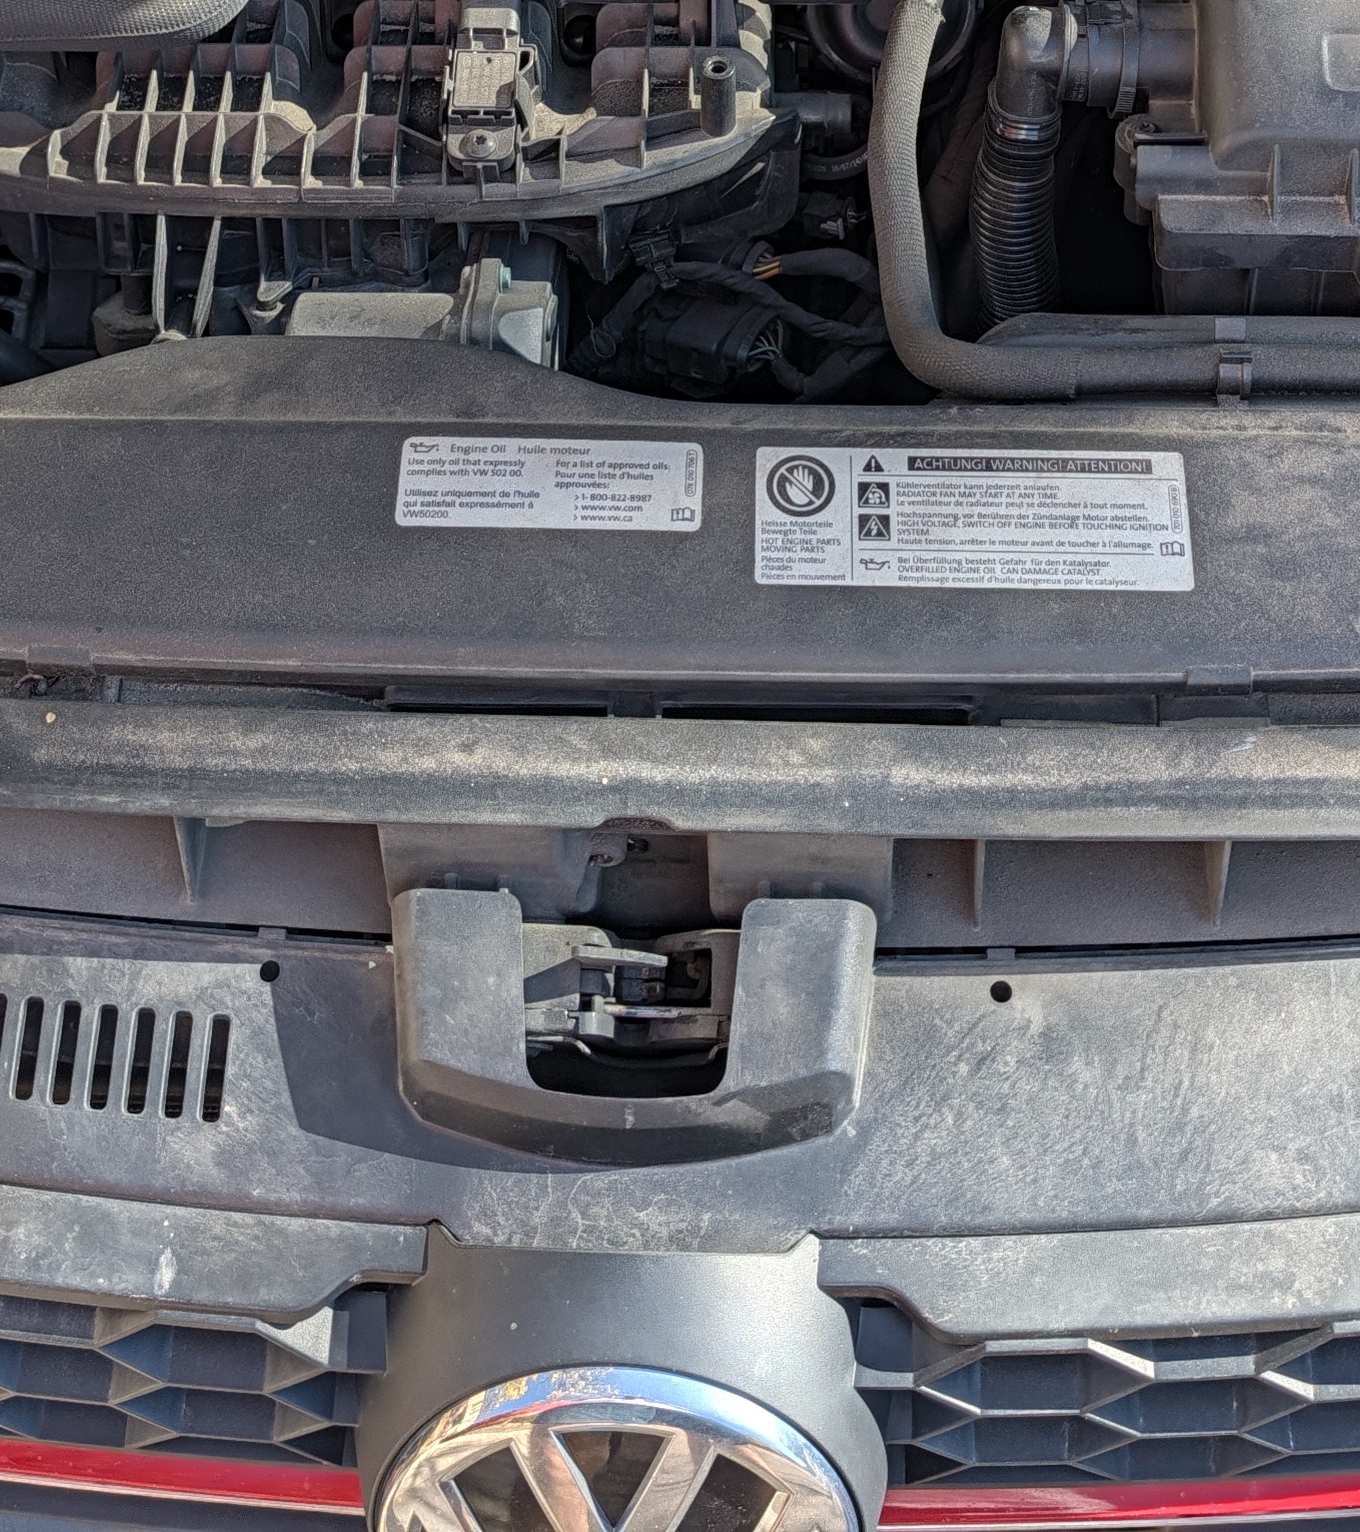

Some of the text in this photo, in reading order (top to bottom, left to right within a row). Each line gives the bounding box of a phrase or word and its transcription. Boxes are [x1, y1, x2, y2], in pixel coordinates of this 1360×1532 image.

[450, 444, 591, 456] Engine Oil Huile moteur
[407, 457, 526, 468] Use only oil that expressly
[556, 459, 671, 471] For list of approved oils:
[914, 458, 1147, 472] ACHTUNG! WARNING! ATTENTION!
[406, 468, 524, 478] complies with VW 502 00.
[555, 471, 654, 481] Pour une liste d'huiles
[554, 480, 610, 490] approuvées:
[896, 481, 1062, 492] Kühlerventilator kann jederzeit anlaufen.
[404, 488, 540, 499] Utilisez uniquement de l'huile
[581, 493, 652, 503] 1-800-822-8987
[896, 490, 937, 498] RADIATOR
[939, 490, 956, 498] FAN
[958, 490, 977, 499] MAY
[980, 491, 1003, 499] START
[1017, 492, 1035, 500] ANY
[1037, 492, 1060, 500] TIME.
[403, 499, 525, 510] qui satisfait expressément
[581, 505, 643, 513] www.vw.com
[896, 499, 905, 507] Le
[907, 499, 952, 507] ventilateur
[954, 499, 964, 507] de
[965, 500, 1003, 508] radiateur
[1005, 501, 1024, 510] peut
[402, 510, 451, 519] VW50200.
[580, 515, 633, 523] www.vw.ca
[896, 510, 961, 521] Hochspannung,
[977, 511, 1015, 520] Berühren
[1016, 512, 1030, 521] der
[1032, 513, 1080, 523] Zündanlage
[1082, 513, 1109, 521] Motor
[1110, 514, 1150, 522] abstellen.
[761, 520, 834, 528] Heisse Motorteile
[896, 519, 919, 527] HIGH
[962, 520, 994, 528] SWITCH
[996, 521, 1012, 529] OFF
[1014, 521, 1046, 529] ENGINE
[1048, 522, 1080, 530] BEFORE
[1081, 523, 1128, 531] TOUCHING
[1129, 523, 1169, 532] IGNITION
[761, 528, 797, 537] Bewegte
[897, 528, 932, 536] SYSTEM.
[761, 537, 841, 546] HOT ENGINE PARTS
[897, 537, 923, 545] Haute
[925, 538, 958, 546] tension,
[959, 537, 987, 546] arrêter
[989, 538, 997, 546] le
[1055, 539, 1066, 547] de
[1067, 540, 1100, 548] toucher
[1108, 540, 1154, 550] l'allumage.
[761, 545, 825, 554] MOVING PARTS
[761, 555, 827, 564] Pièces du moteur
[897, 555, 1112, 569] Bei Überfüllung besteht Gefahr für den Katalysator.
[761, 563, 793, 571] chaudes
[897, 565, 1103, 577] OVERFILLED ENGINE OIL CAN DAMAGE CATALYST.
[761, 572, 785, 580] Pièces
[798, 573, 846, 581] mouvement
[898, 574, 1140, 588] Remplissage excessif d'huile dangereux pour le catalyseur.
